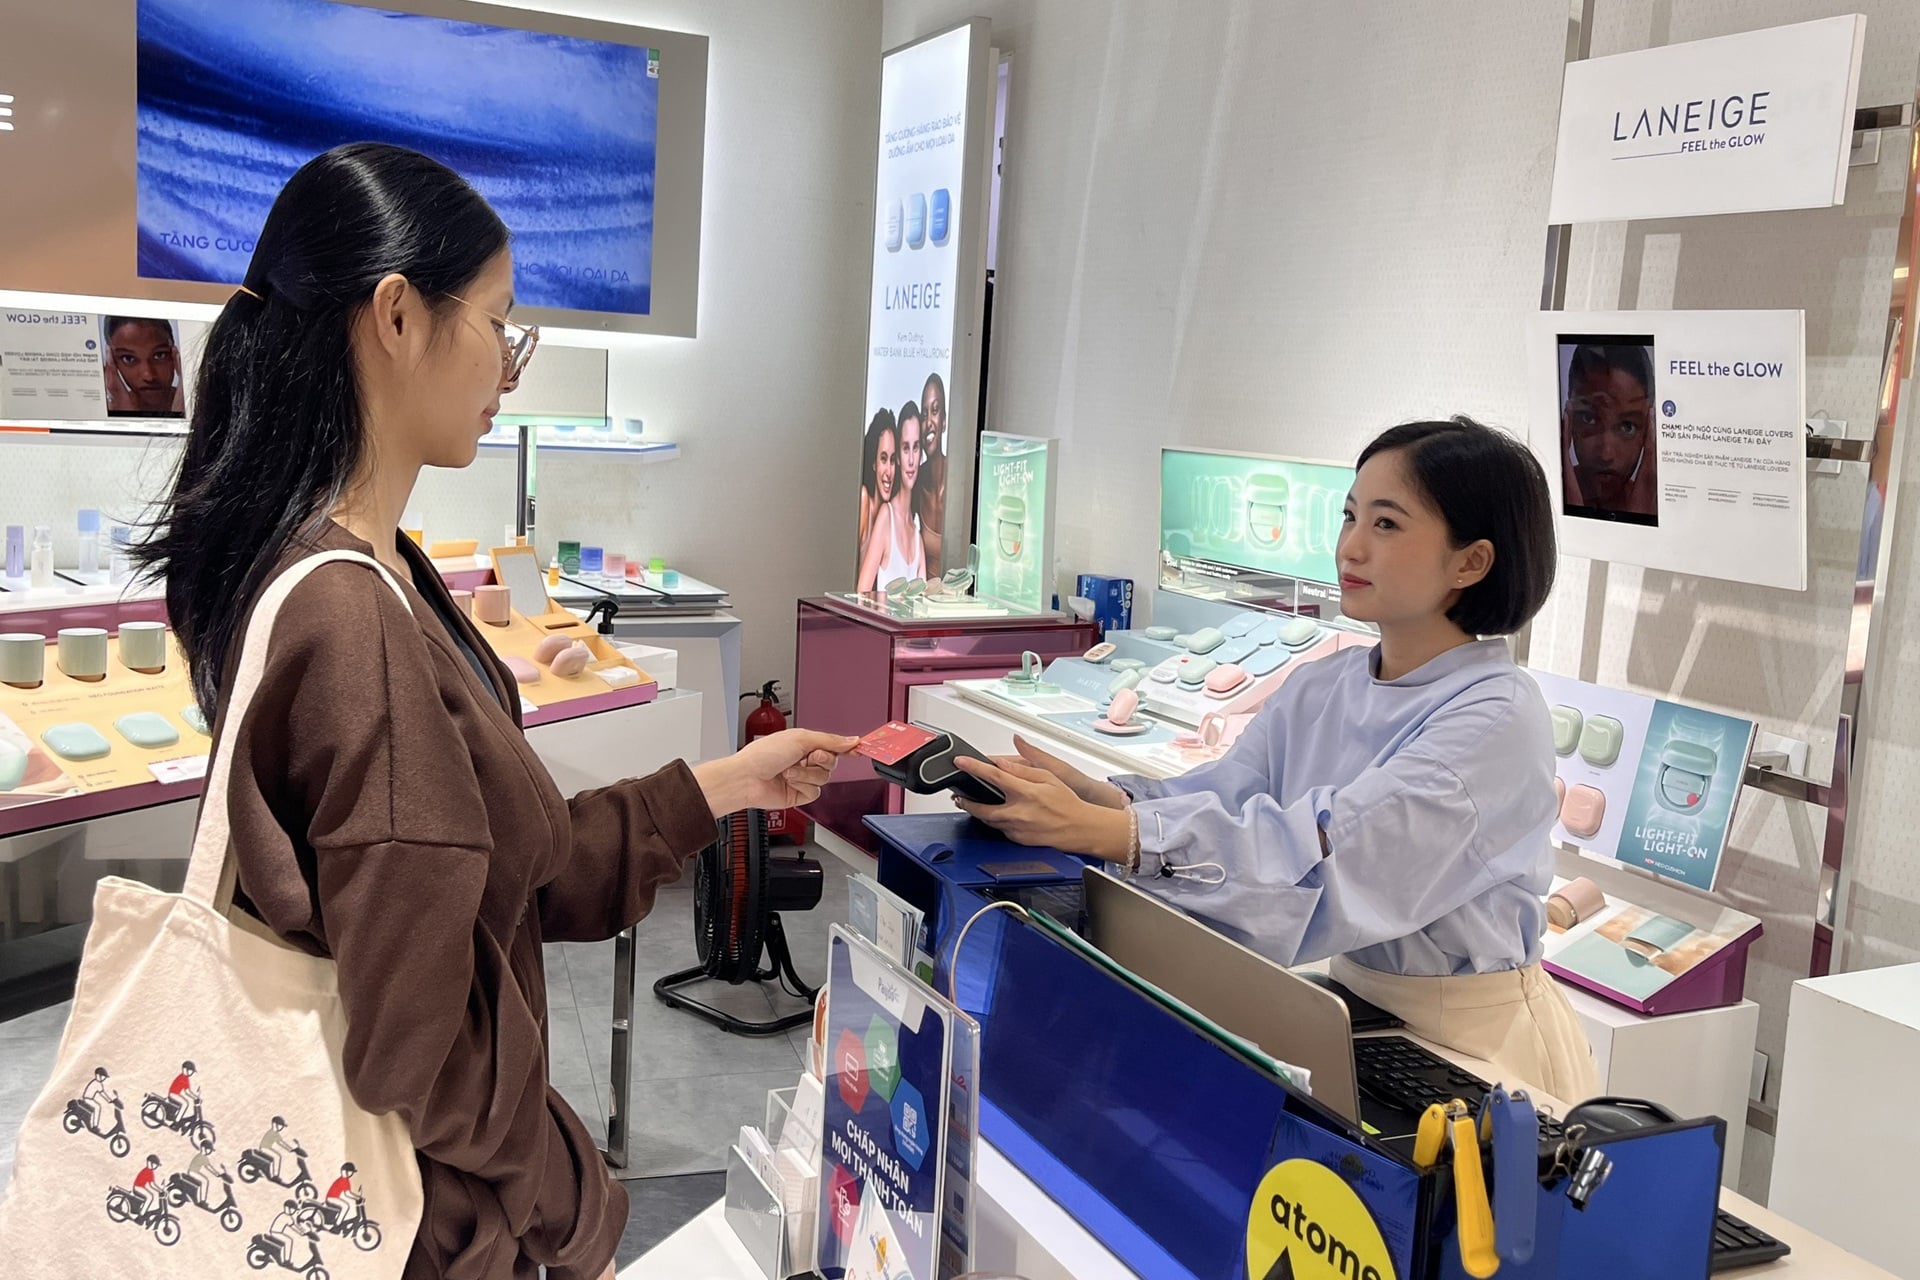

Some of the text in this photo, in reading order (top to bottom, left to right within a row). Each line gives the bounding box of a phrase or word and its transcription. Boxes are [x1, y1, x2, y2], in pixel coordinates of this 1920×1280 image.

[1613, 92, 1770, 141] LANEIGE
[1682, 133, 1765, 153] FEEL the GLOW
[160, 230, 210, 249] TĂNG
[885, 282, 942, 310] LANEIGE
[1670, 360, 1783, 378] FEEL the GLOW
[1713, 434, 1742, 443] LANEIGE
[1733, 427, 1763, 436] LANEIGE
[1765, 430, 1793, 439] LOVERS
[993, 460, 1027, 476] LIGHT-FIT
[1635, 826, 1698, 845] LIGHT-FIT
[1643, 840, 1708, 859] LIGHT-ON
[847, 1119, 876, 1157] CHẤP
[877, 1148, 910, 1195] NHẬN
[831, 1130, 852, 1165] MỌI
[853, 1152, 890, 1204] THANH
[891, 1190, 923, 1238] TOÁN
